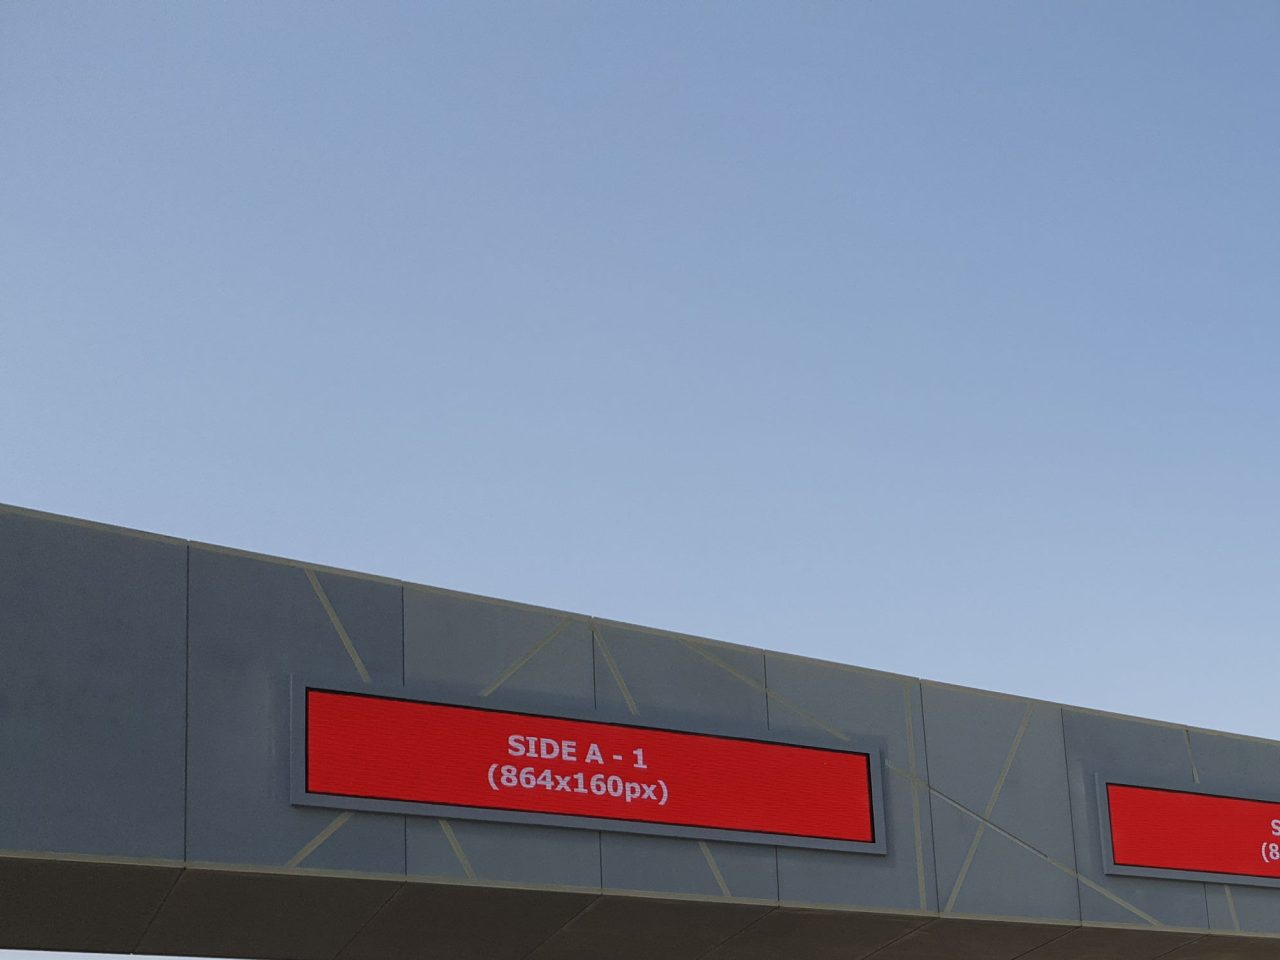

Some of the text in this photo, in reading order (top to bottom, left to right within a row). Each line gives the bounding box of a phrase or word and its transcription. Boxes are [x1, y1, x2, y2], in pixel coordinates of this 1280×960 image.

[508, 734, 577, 761] SIDE
[585, 743, 604, 765] A
[632, 748, 648, 769] 1
[487, 763, 669, 806] (864x160px)
